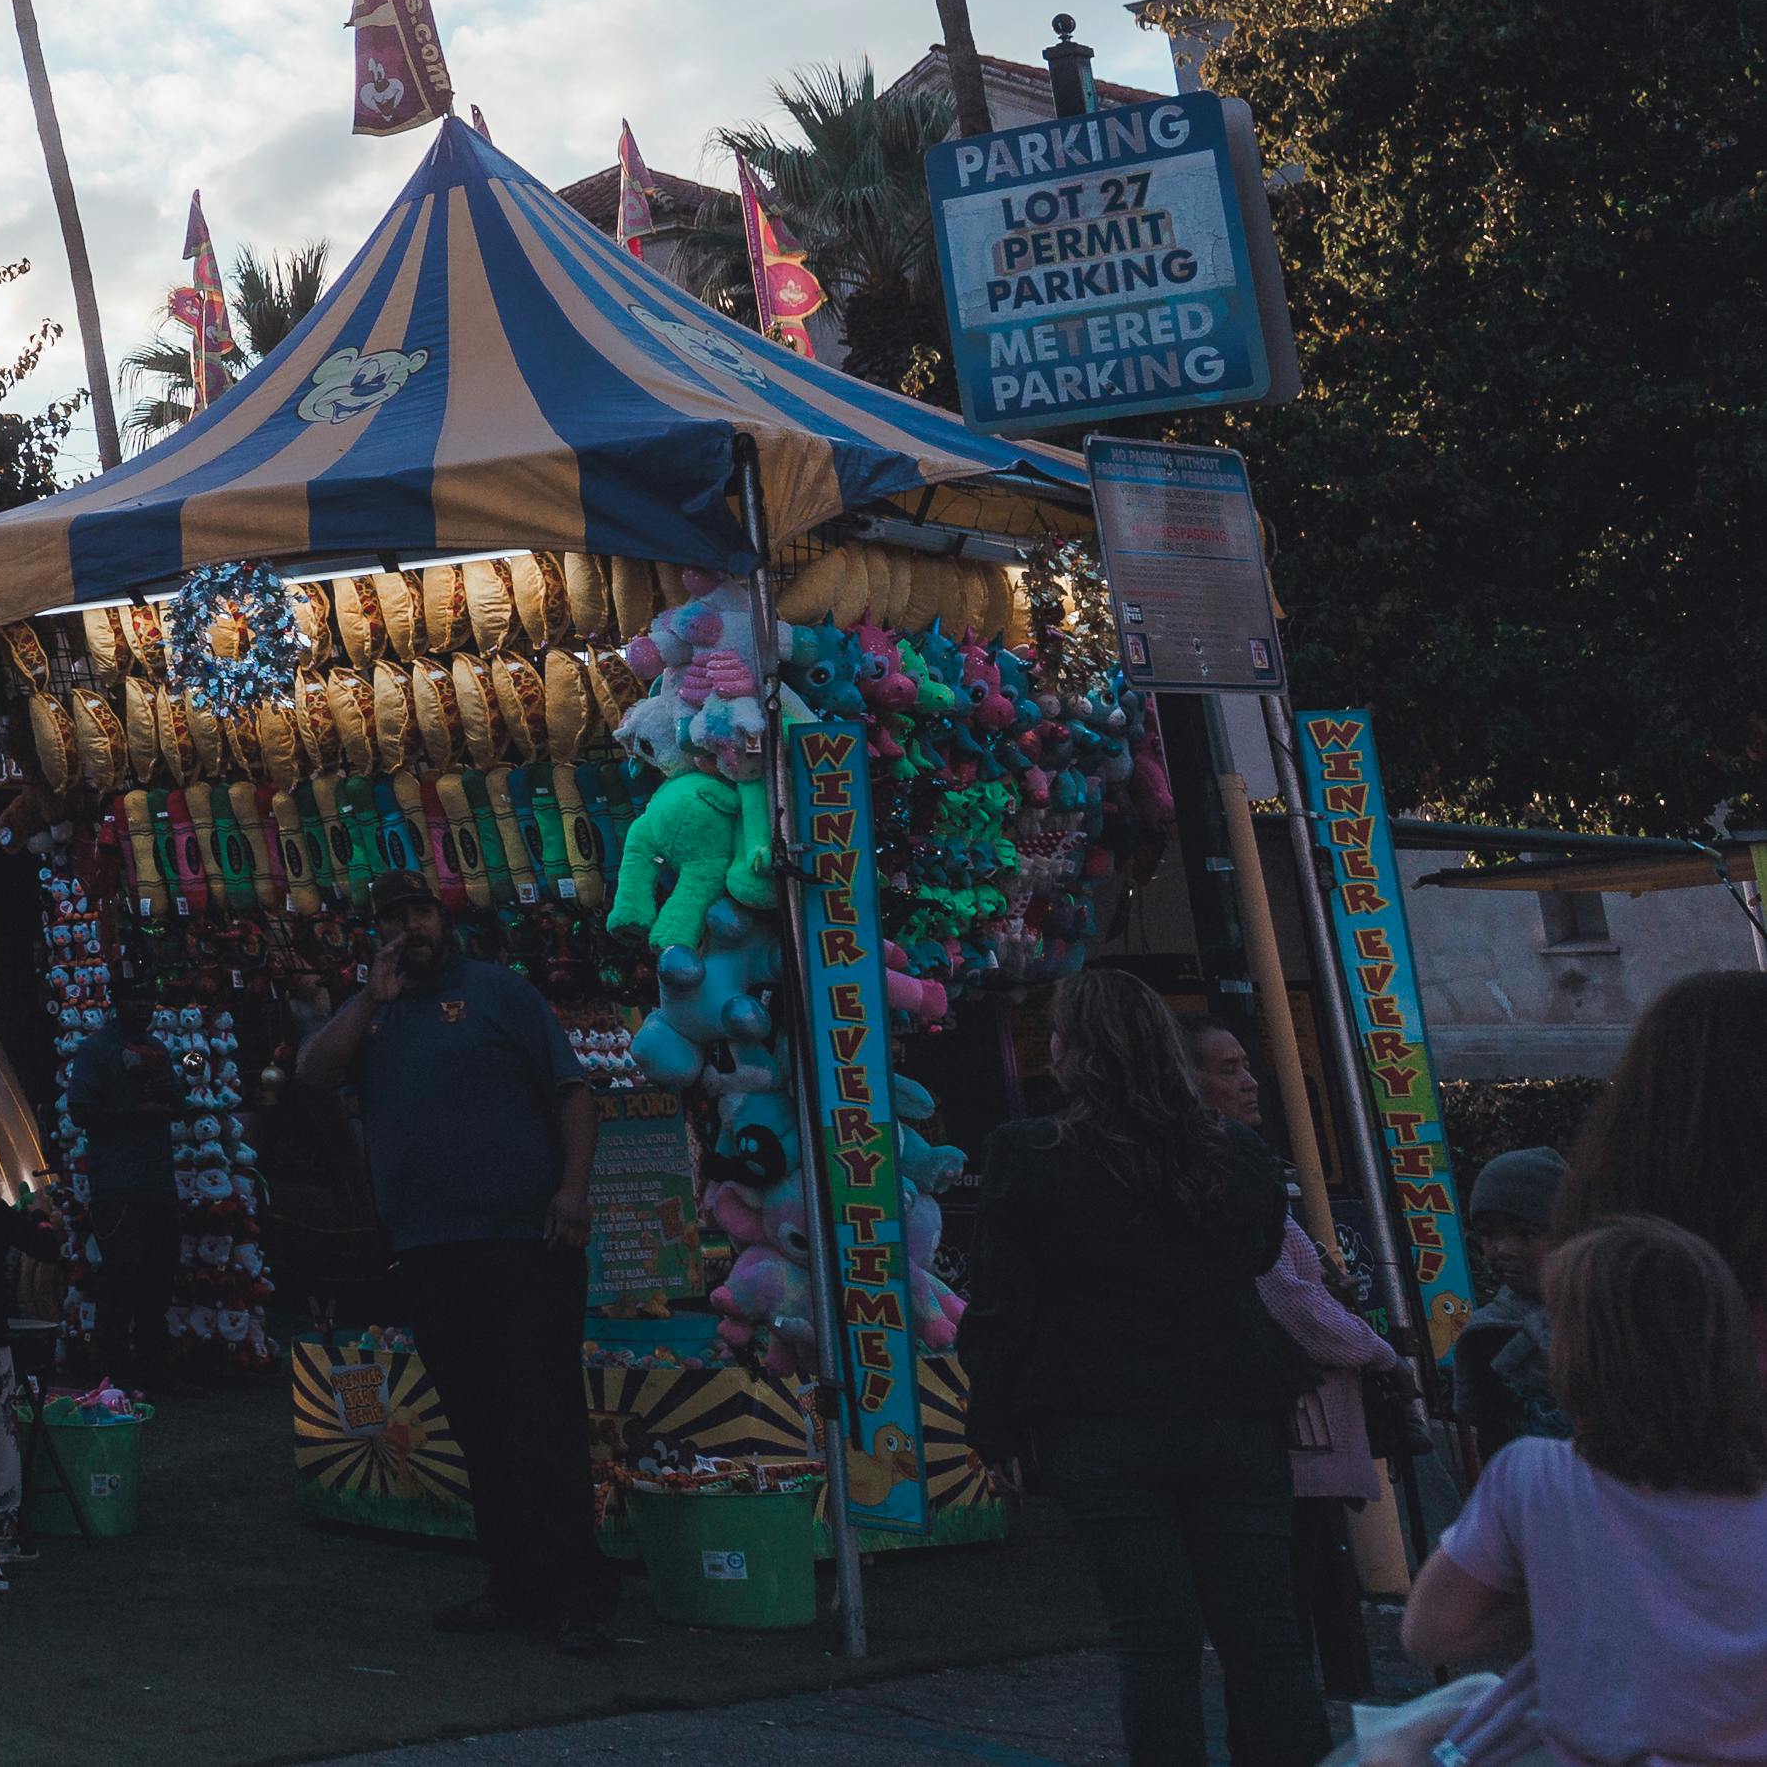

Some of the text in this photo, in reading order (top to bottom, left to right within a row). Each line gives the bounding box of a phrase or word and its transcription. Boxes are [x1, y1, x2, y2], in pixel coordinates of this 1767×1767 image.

[955, 105, 1190, 187] PARKING
[1002, 171, 1153, 230] LOT 27
[1004, 212, 1165, 270] PERMIT
[986, 250, 1198, 313] PARKING
[990, 303, 1214, 369] METERED
[992, 346, 1225, 411] PARKING
[1110, 448, 1220, 471] NO PARKING WITHOUT
[1182, 471, 1244, 488] PERMISSION
[1308, 717, 1455, 1283] WINNER EVERY TIME!
[800, 732, 905, 1413] WINNER EVERY TIME!
[623, 1092, 679, 1119] POND
